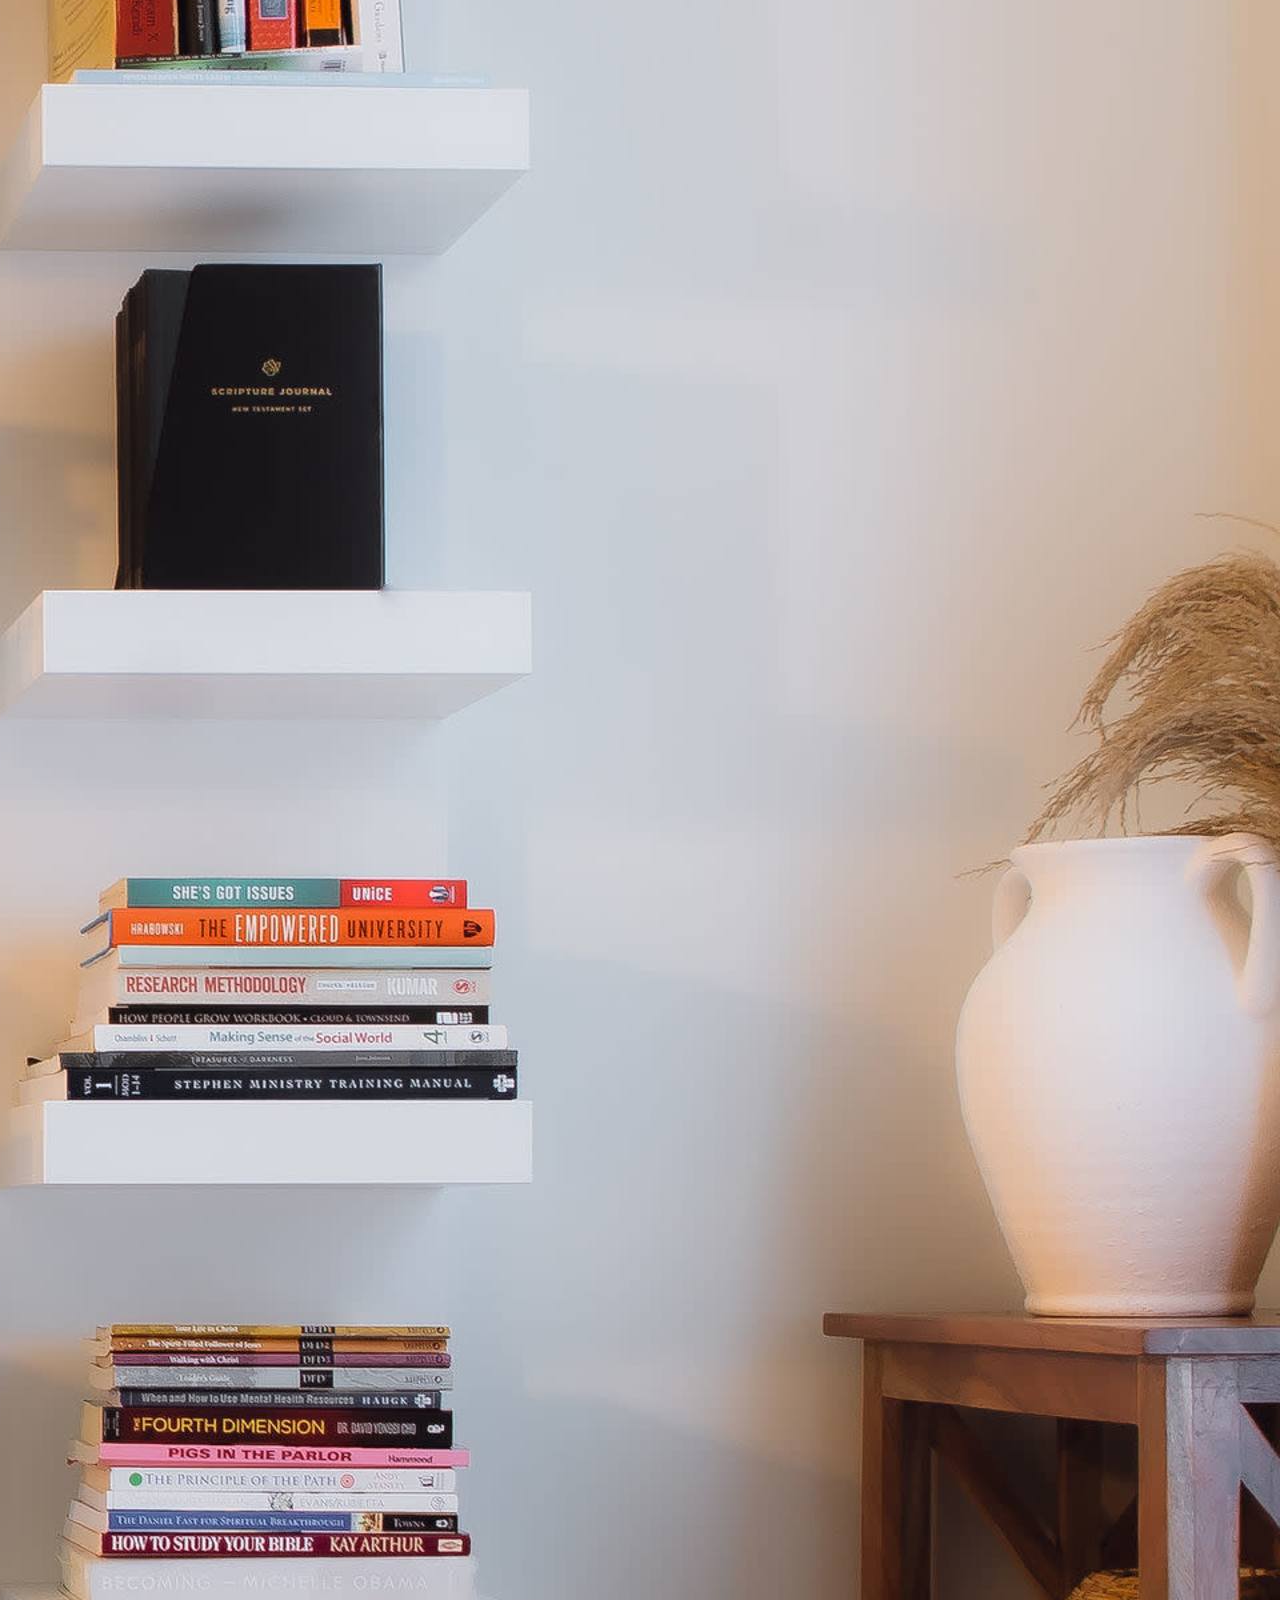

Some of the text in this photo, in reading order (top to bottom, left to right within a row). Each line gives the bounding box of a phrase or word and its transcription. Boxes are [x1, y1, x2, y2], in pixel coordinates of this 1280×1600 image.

[173, 886, 294, 901] SHE'S GOT ISSUES
[200, 914, 443, 943] THE EMPOWERED UNIVERSITY
[126, 976, 306, 995] RESEARCH METHODOLOGY
[143, 1417, 325, 1435] FOURTH DIMENSION
[169, 1448, 352, 1462] PIGS IN THE PARLOR
[112, 1536, 314, 1552] HOW TO STUDY YOUR BIBLE
[330, 1537, 424, 1552] KAY ARTHUR
